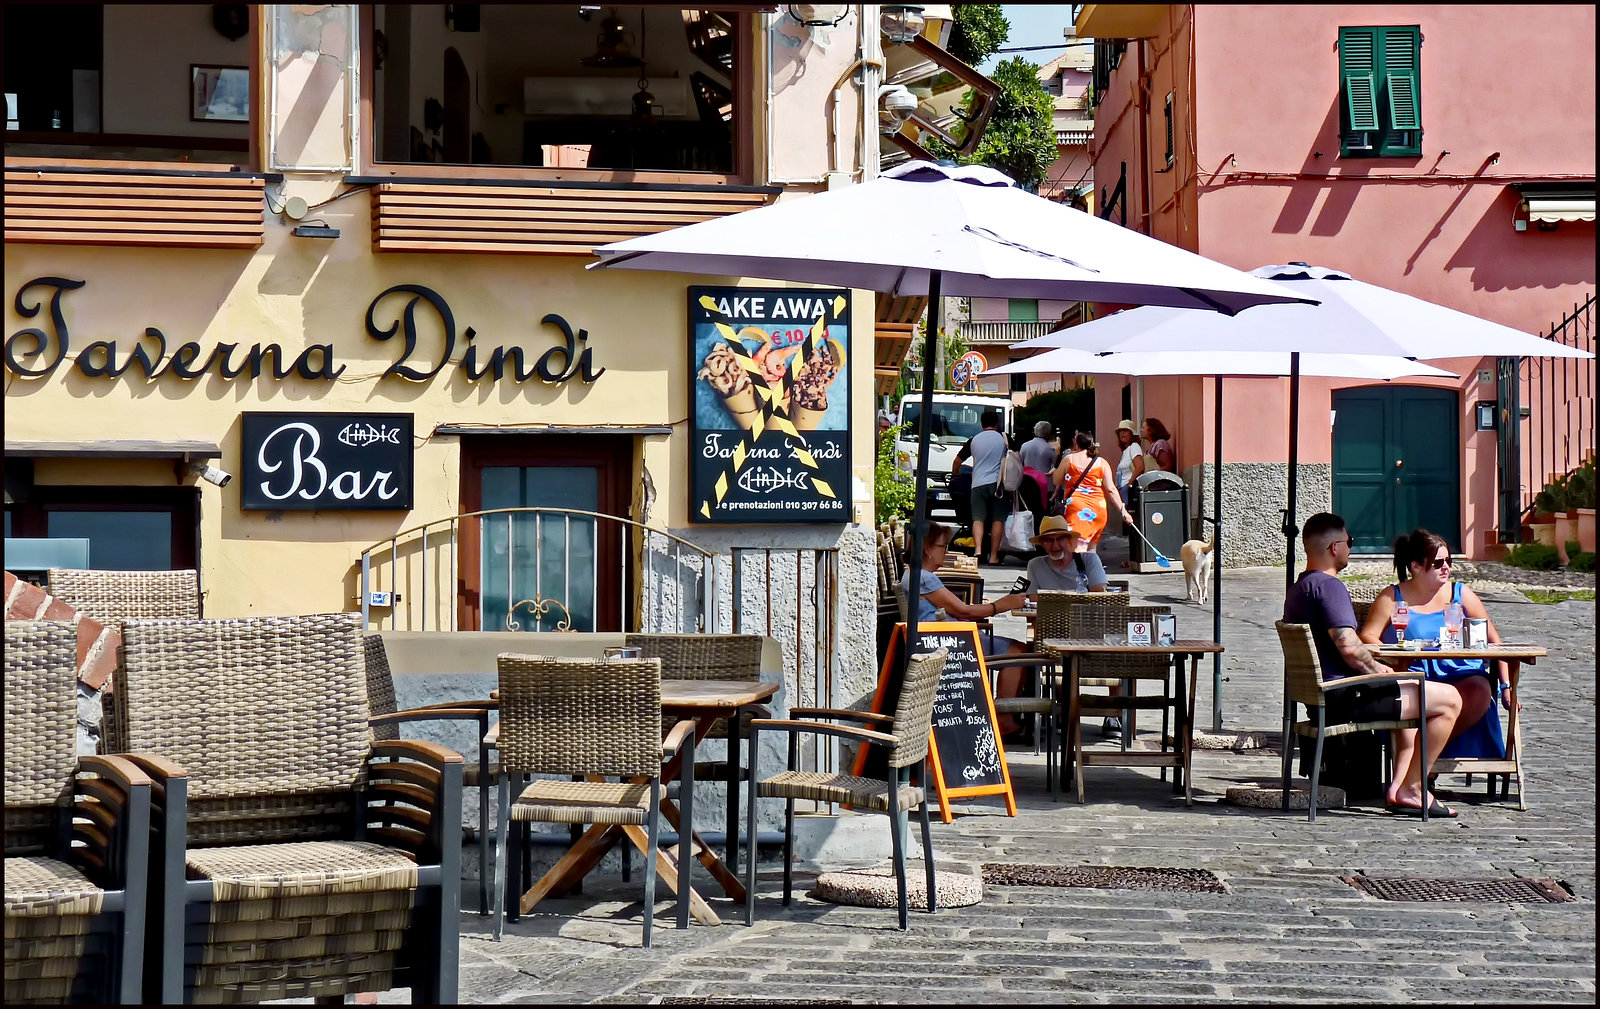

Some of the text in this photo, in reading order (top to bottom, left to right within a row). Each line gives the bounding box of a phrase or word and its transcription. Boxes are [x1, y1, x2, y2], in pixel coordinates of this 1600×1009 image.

[5, 276, 606, 383] Taverna Dindi
[703, 433, 781, 459] Tarna
[258, 422, 399, 500] Bar
[729, 500, 784, 511] prenotazioni
[785, 501, 800, 509] 010
[801, 501, 817, 511] 307
[819, 501, 831, 509] 66
[832, 501, 843, 509] 86
[933, 704, 954, 714] TOAST
[938, 716, 963, 728] INSALATA
